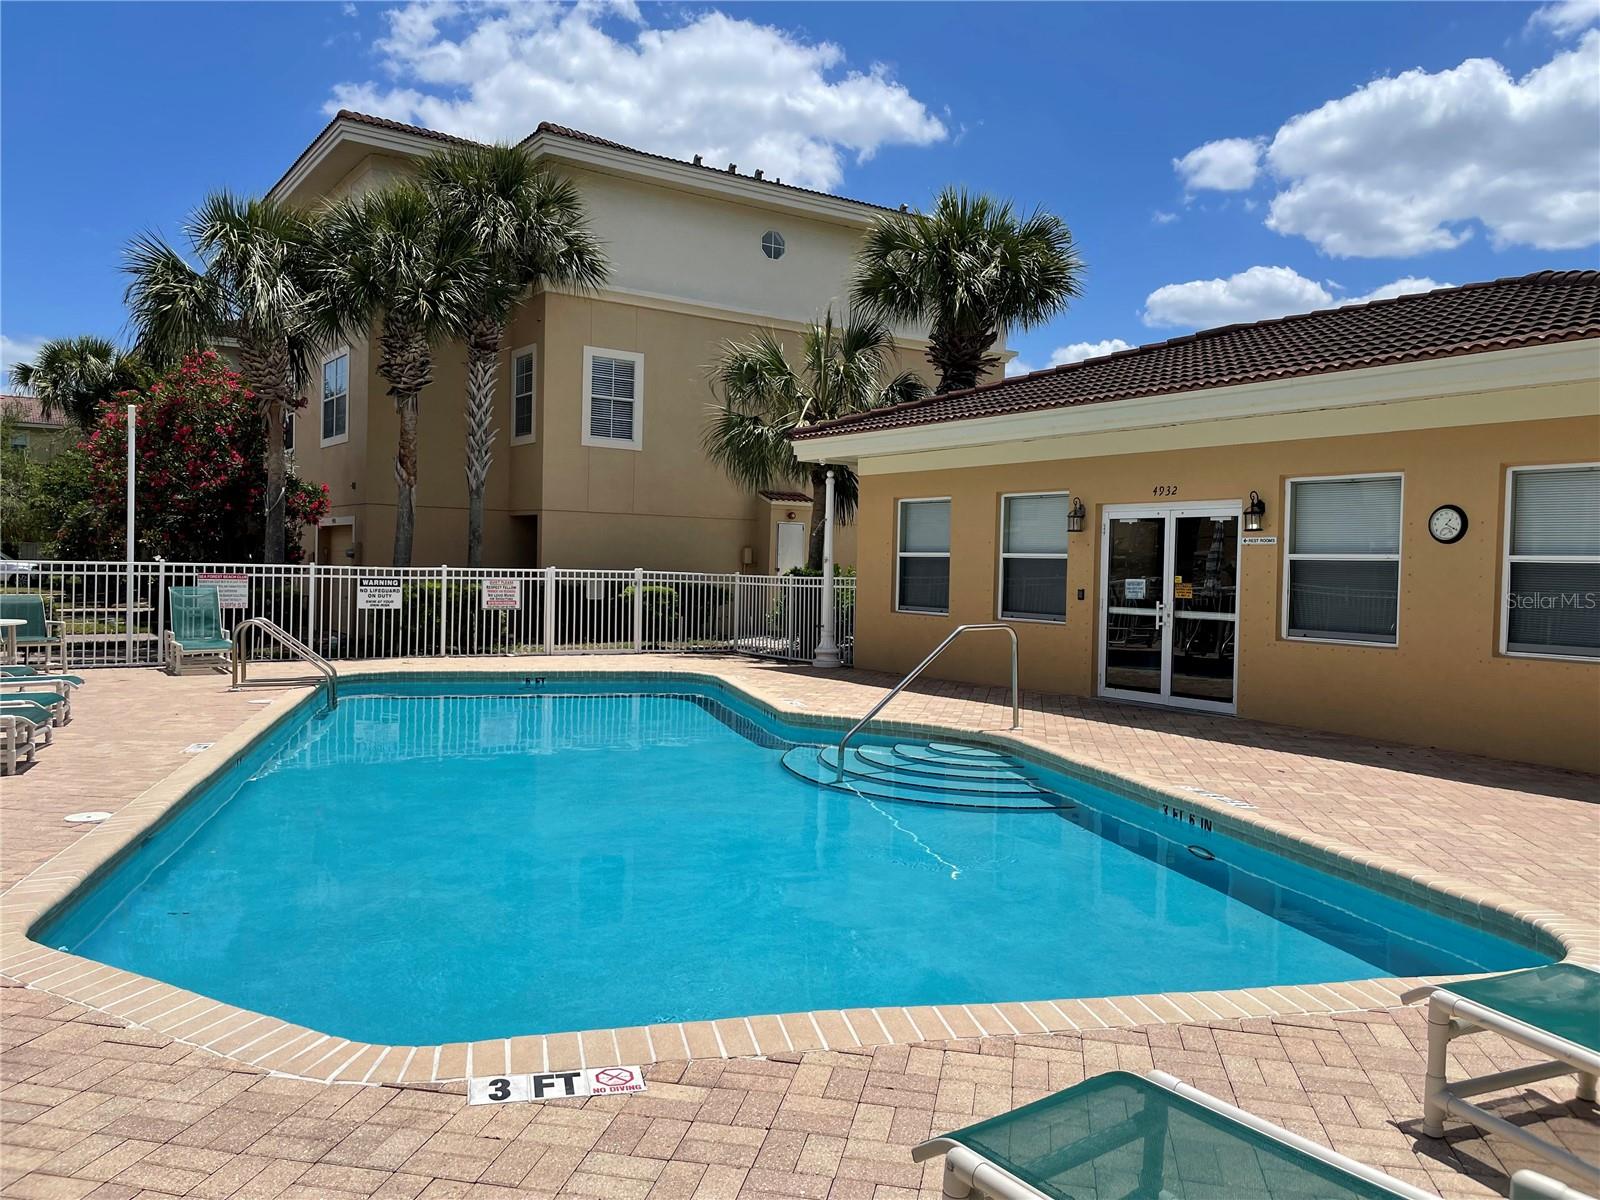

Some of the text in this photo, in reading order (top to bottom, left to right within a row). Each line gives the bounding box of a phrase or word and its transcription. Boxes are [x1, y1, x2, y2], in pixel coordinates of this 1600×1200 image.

[1152, 486, 1178, 496] 4932
[1201, 818, 1212, 832] IN
[488, 1072, 580, 1100] 3 FT
